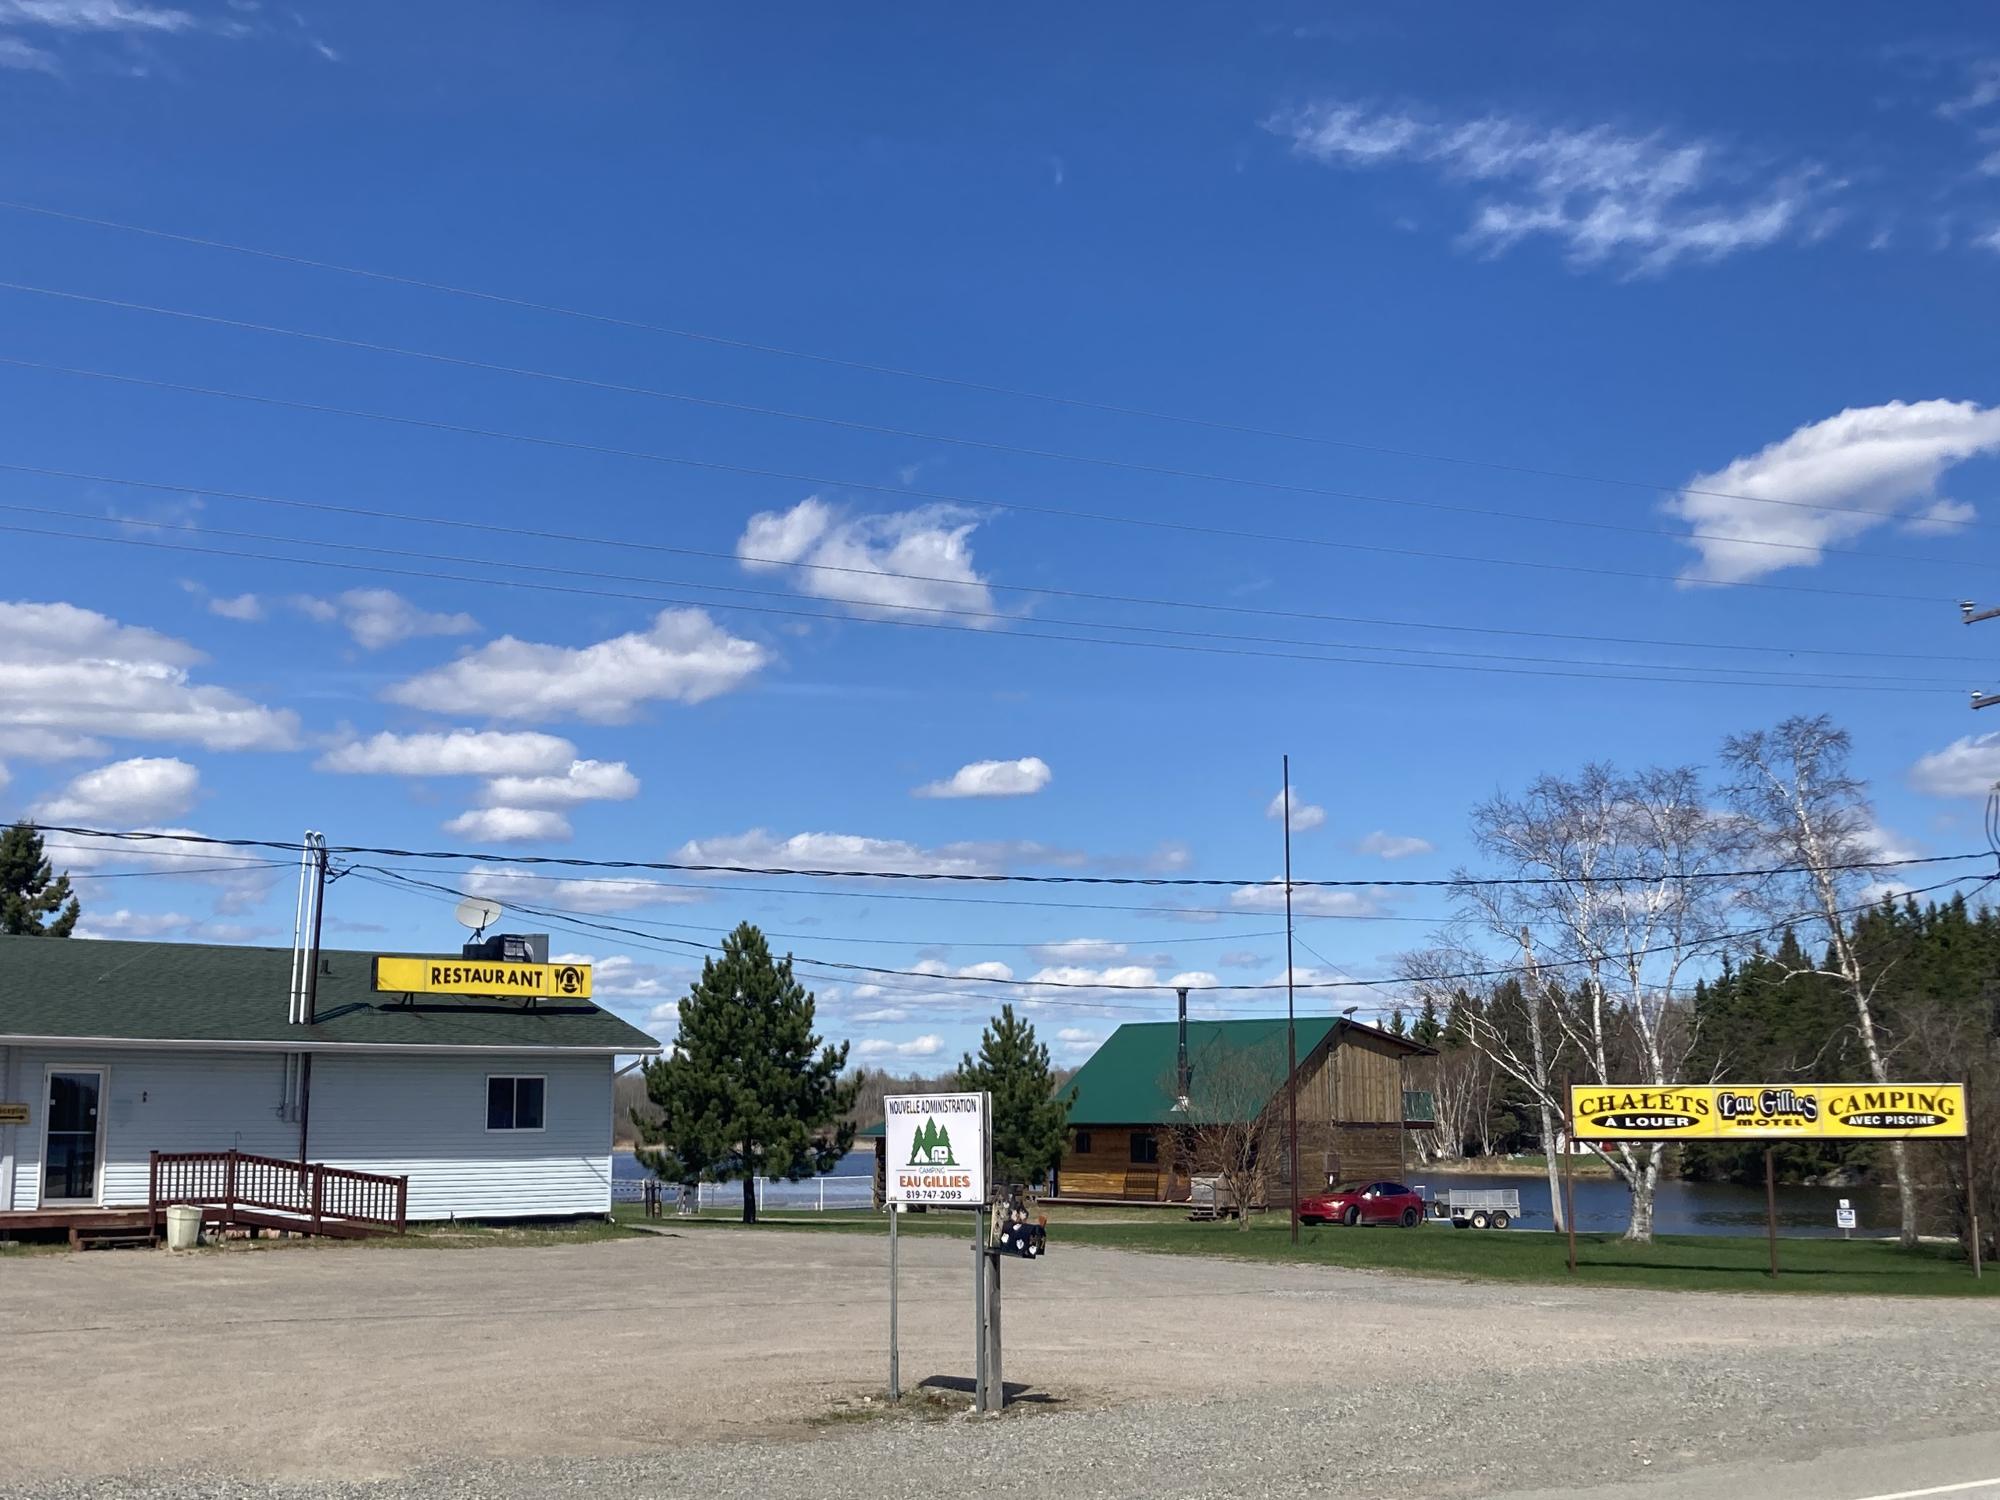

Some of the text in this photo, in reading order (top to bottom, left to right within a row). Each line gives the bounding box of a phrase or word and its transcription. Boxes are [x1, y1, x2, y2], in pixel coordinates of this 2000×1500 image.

[431, 967, 543, 988] RESTAURANT
[889, 1099, 977, 1114] NOUVELLE ADMINISTRATION
[1579, 1093, 1709, 1115] CHALETS
[1717, 1089, 1818, 1123] Eau Gillies
[1828, 1092, 1954, 1115] CAMPING
[1605, 1115, 1689, 1126] À LOUER
[1848, 1115, 1936, 1125] AVEC PISCINE
[899, 1175, 971, 1188] EAU GILLIES
[906, 1190, 962, 1200] 819-747-2093
